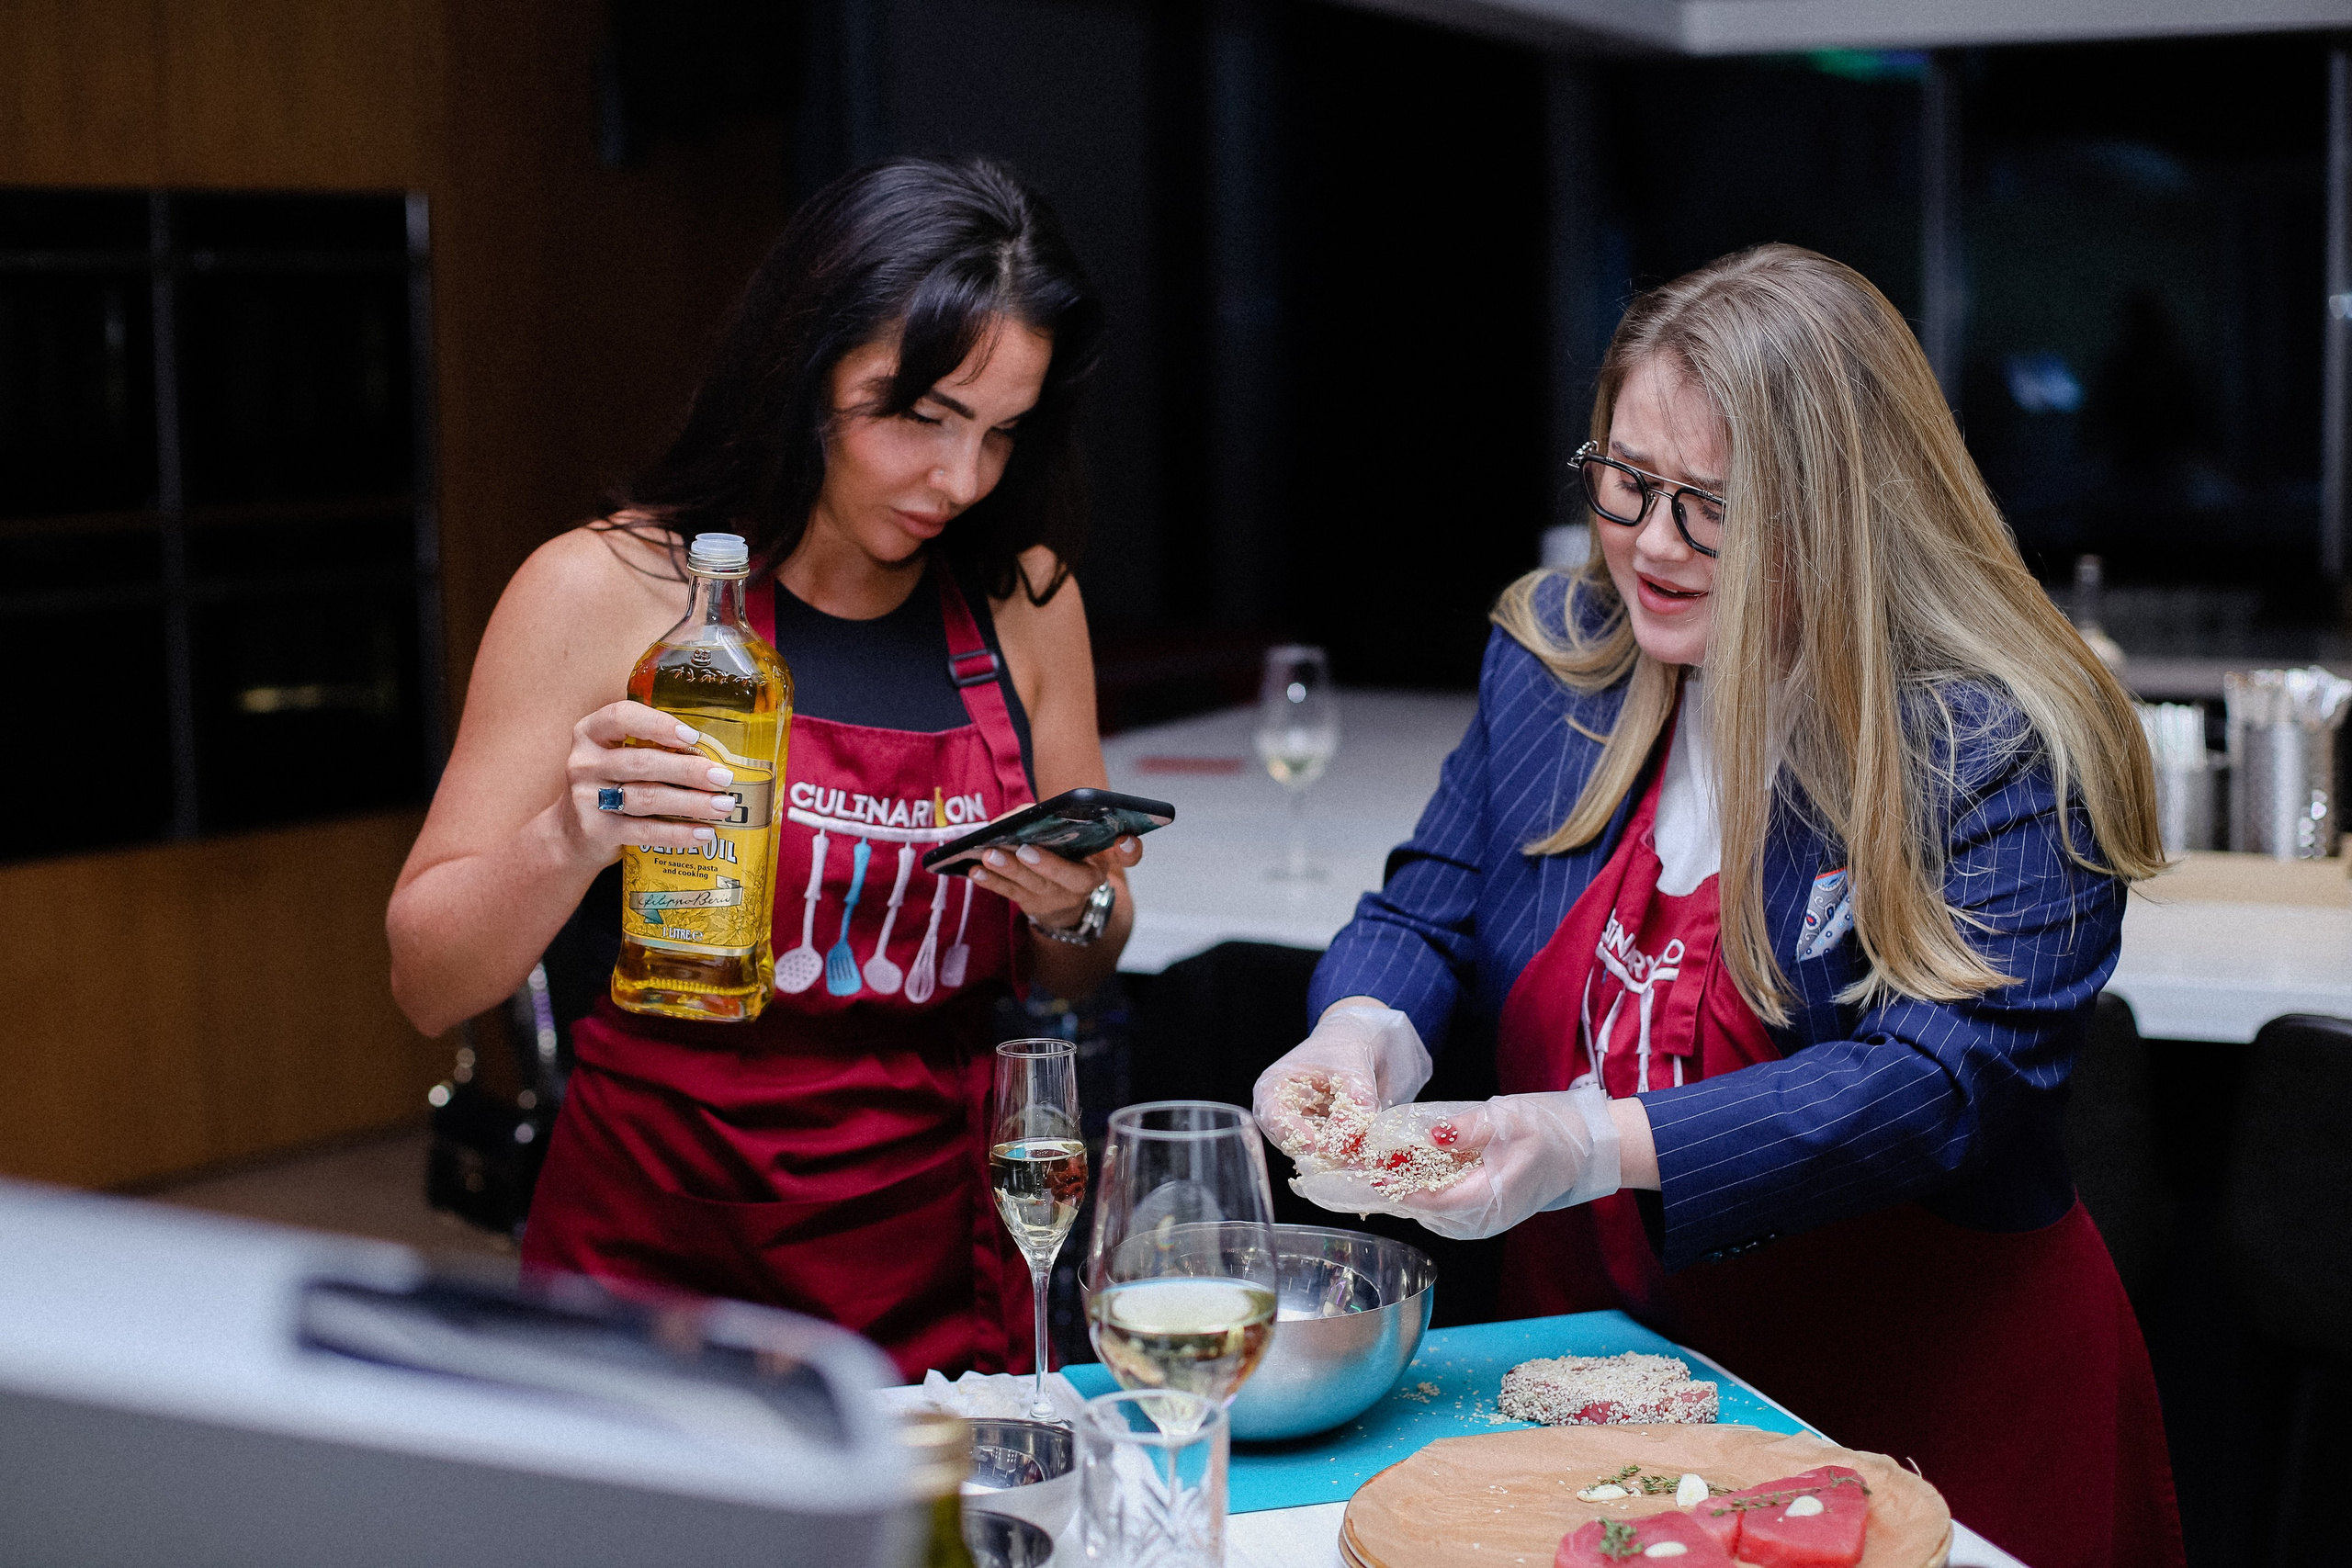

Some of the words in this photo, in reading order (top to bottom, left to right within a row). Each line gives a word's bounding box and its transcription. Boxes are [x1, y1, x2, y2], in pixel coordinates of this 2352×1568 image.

[654, 857, 667, 865] For
[697, 863, 718, 872] pasta
[678, 868, 708, 879] cooking
[693, 891, 731, 906] Berio
[662, 926, 666, 937] 1
[668, 928, 691, 941] LITRE
